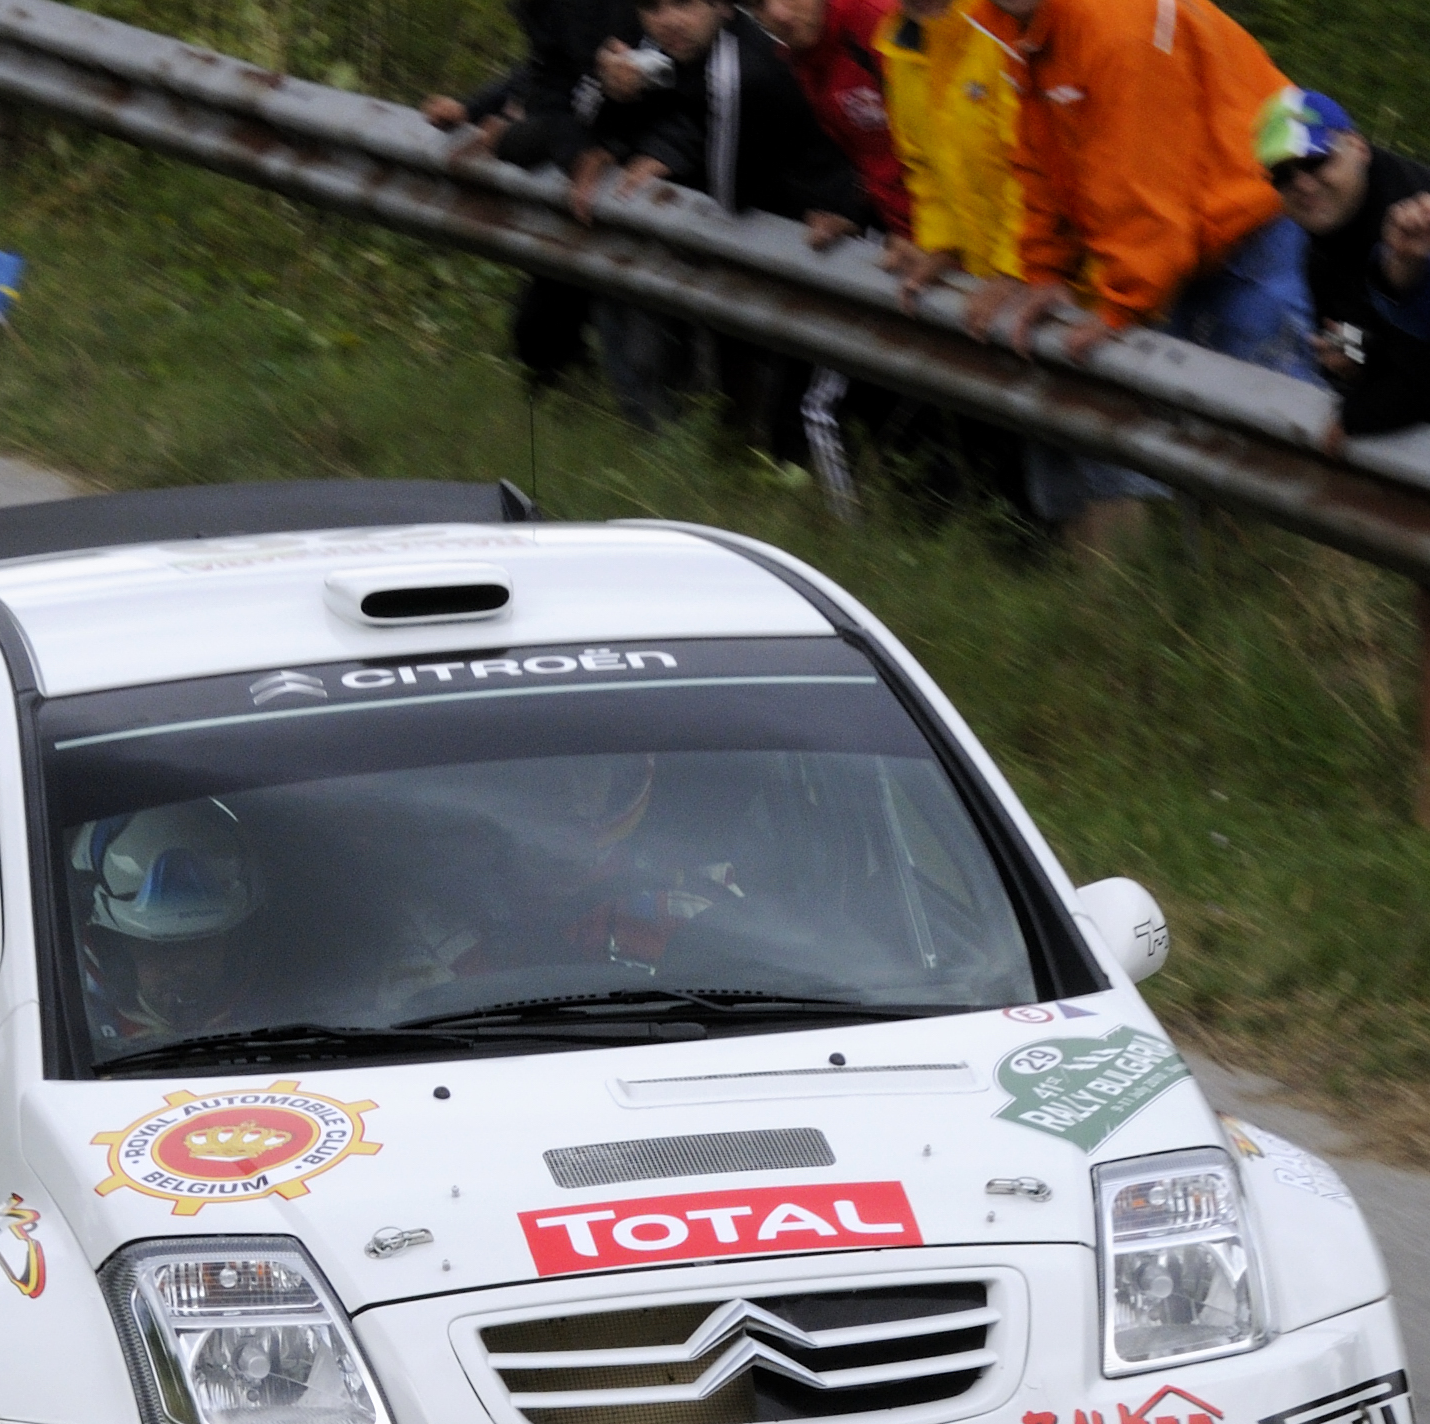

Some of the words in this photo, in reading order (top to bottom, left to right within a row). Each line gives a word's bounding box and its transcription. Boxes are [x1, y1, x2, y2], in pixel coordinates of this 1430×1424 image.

[1014, 1049, 1057, 1071] 29
[124, 1117, 179, 1160] ROYAL
[182, 1094, 347, 1128] AUTOMOBILE
[301, 1130, 348, 1166] CLUB
[1017, 1088, 1108, 1133] RALLY
[141, 1170, 269, 1195] BELGIUM
[535, 1200, 905, 1257] TOTAL
